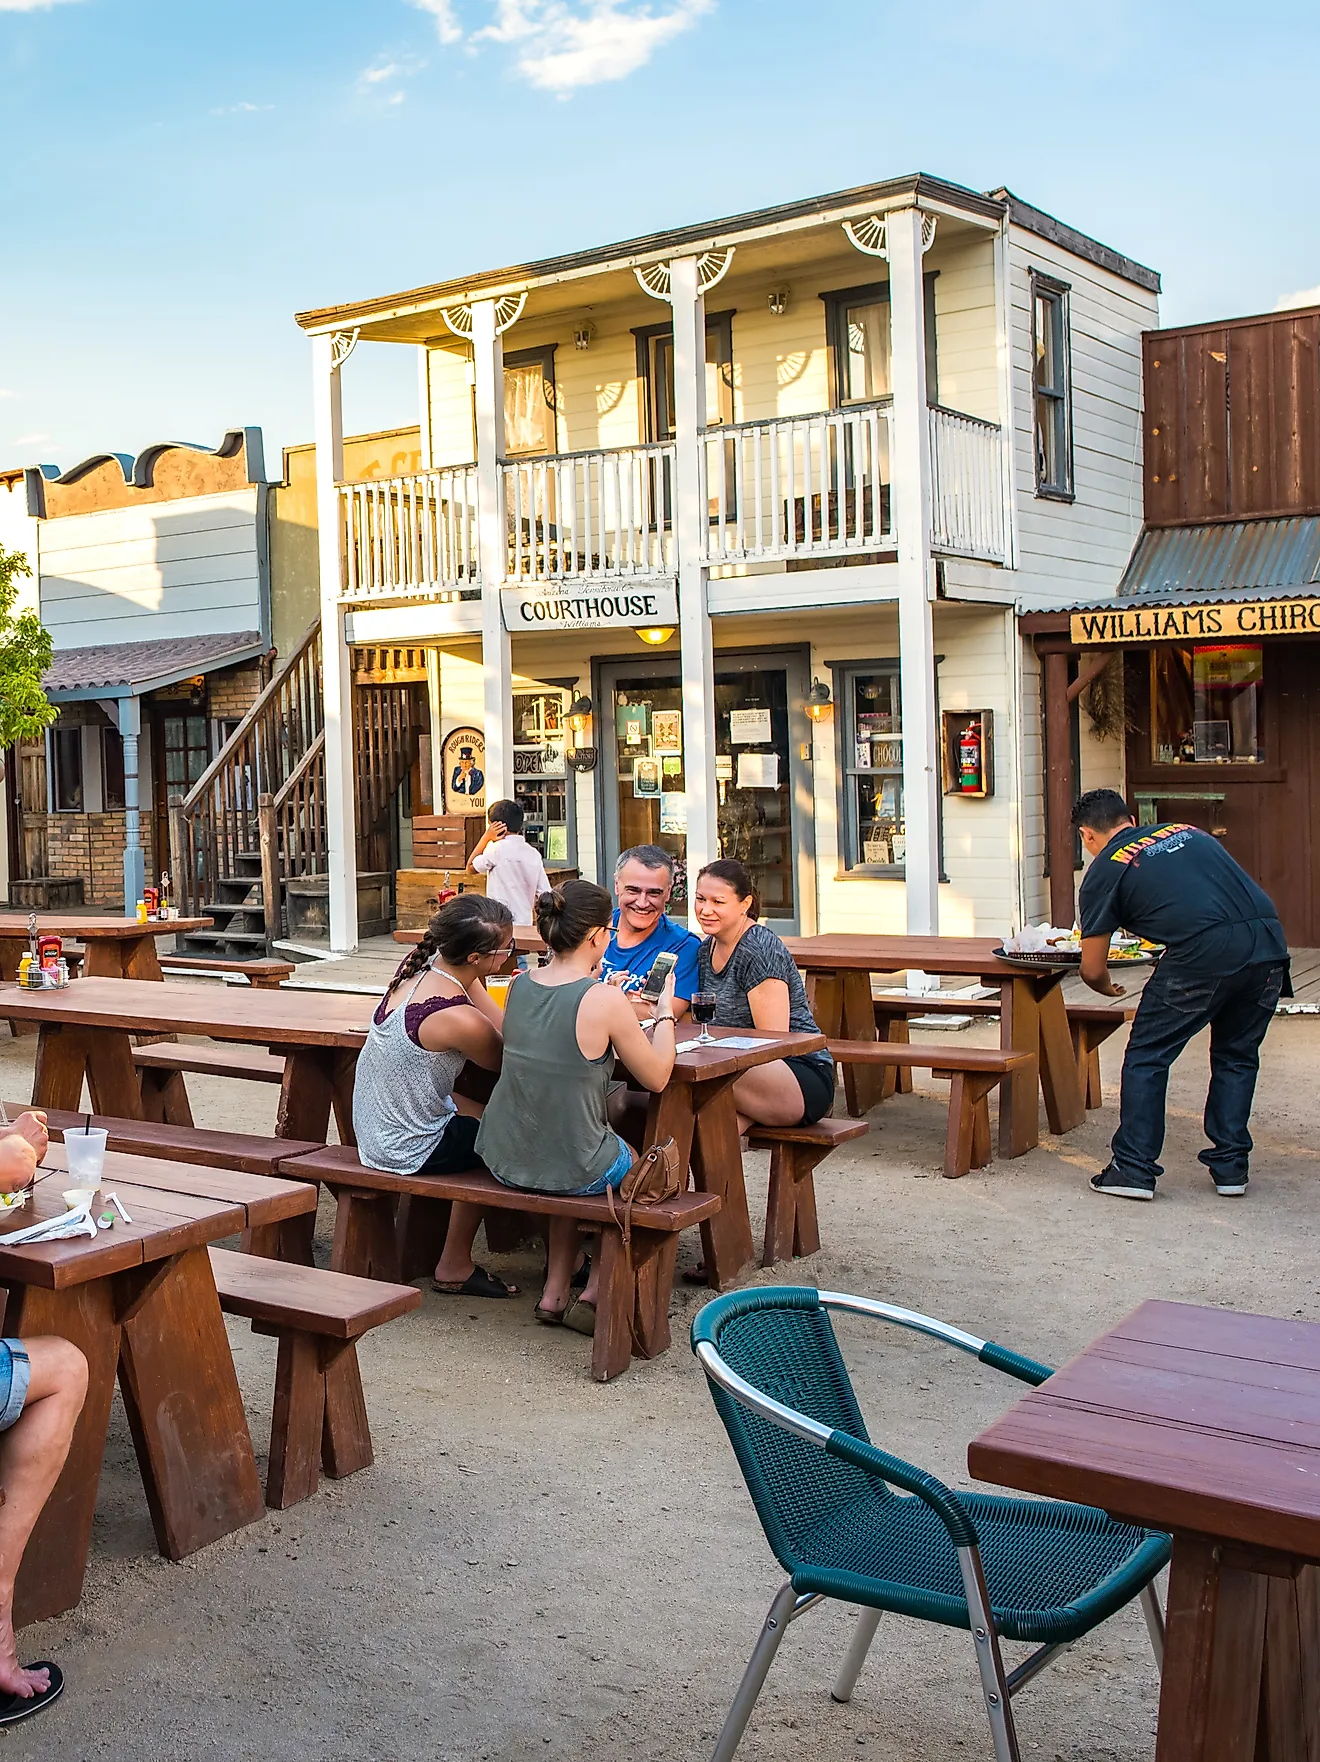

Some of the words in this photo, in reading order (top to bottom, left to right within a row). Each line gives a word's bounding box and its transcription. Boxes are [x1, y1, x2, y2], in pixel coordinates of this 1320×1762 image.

[520, 595, 658, 622] COURTHOUSE
[1080, 609, 1223, 640] WILLIAMS
[448, 735, 465, 754] ROUGH
[469, 797, 485, 808] YOU
[1110, 836, 1157, 865] WILD
